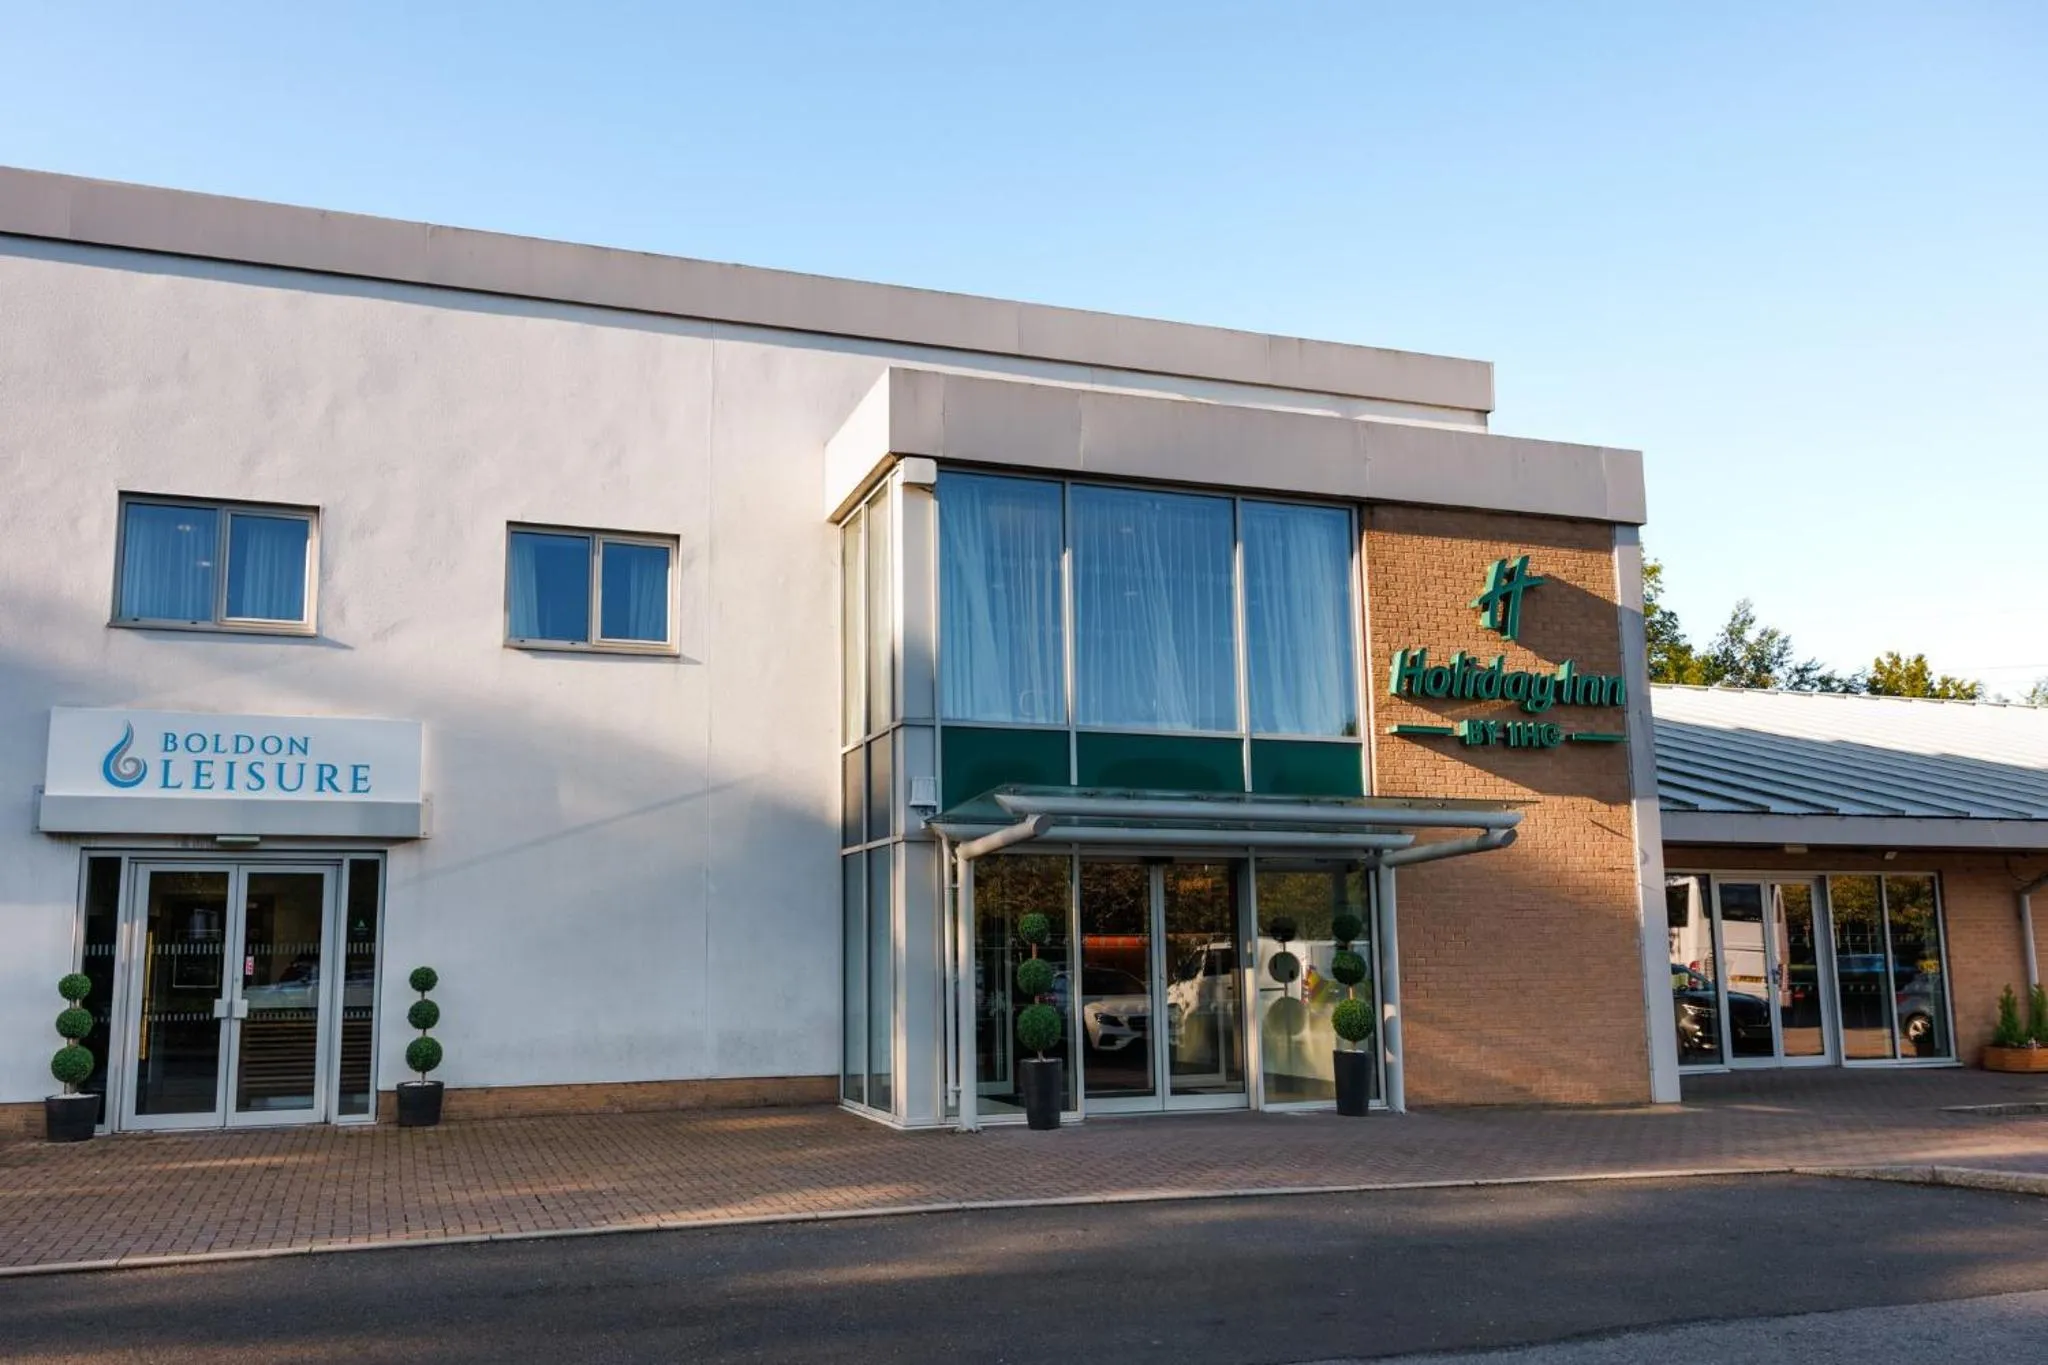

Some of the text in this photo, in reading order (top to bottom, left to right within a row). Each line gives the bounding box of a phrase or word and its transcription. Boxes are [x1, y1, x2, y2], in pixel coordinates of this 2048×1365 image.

[1469, 555, 1546, 640] H
[1389, 647, 1626, 713] Holiday Inn
[162, 732, 311, 756] BOLDON
[1459, 719, 1563, 748] BY IHG
[160, 760, 372, 793] LEISURE
